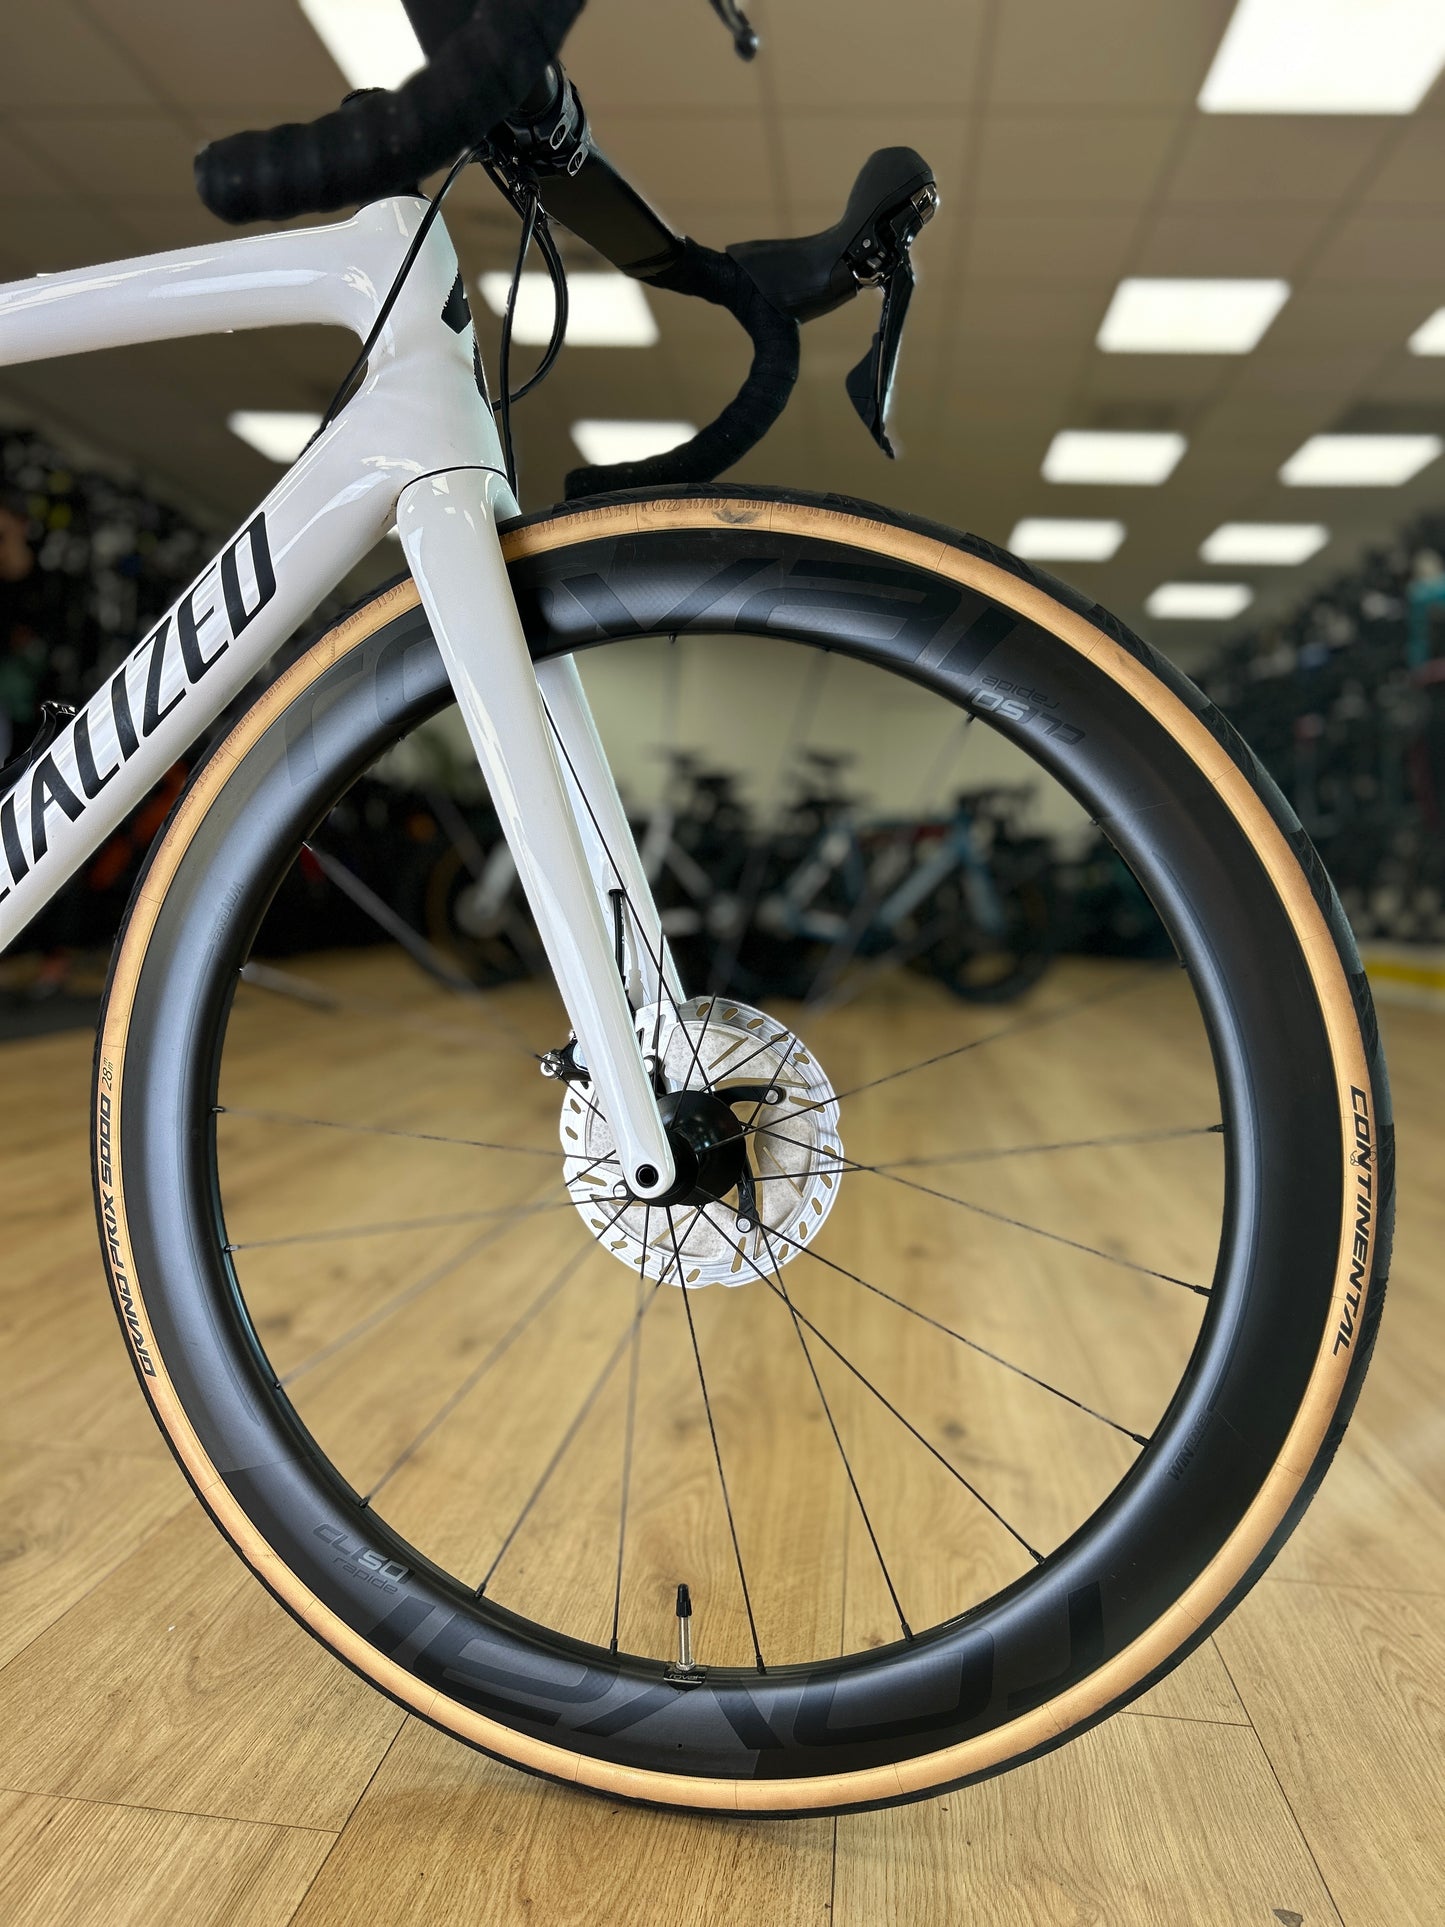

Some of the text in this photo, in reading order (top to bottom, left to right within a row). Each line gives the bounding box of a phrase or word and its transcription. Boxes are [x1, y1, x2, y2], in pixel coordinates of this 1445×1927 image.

[736, 500, 769, 511] MOUNT
[0, 511, 277, 902] IALIZED
[981, 675, 1061, 709] rapide
[99, 1091, 113, 1188] 5000
[103, 1189, 125, 1270] PRIX
[1333, 1084, 1372, 1357] CONTINENTAL
[115, 1271, 157, 1378] GRAND
[333, 1557, 399, 1595] rapide
